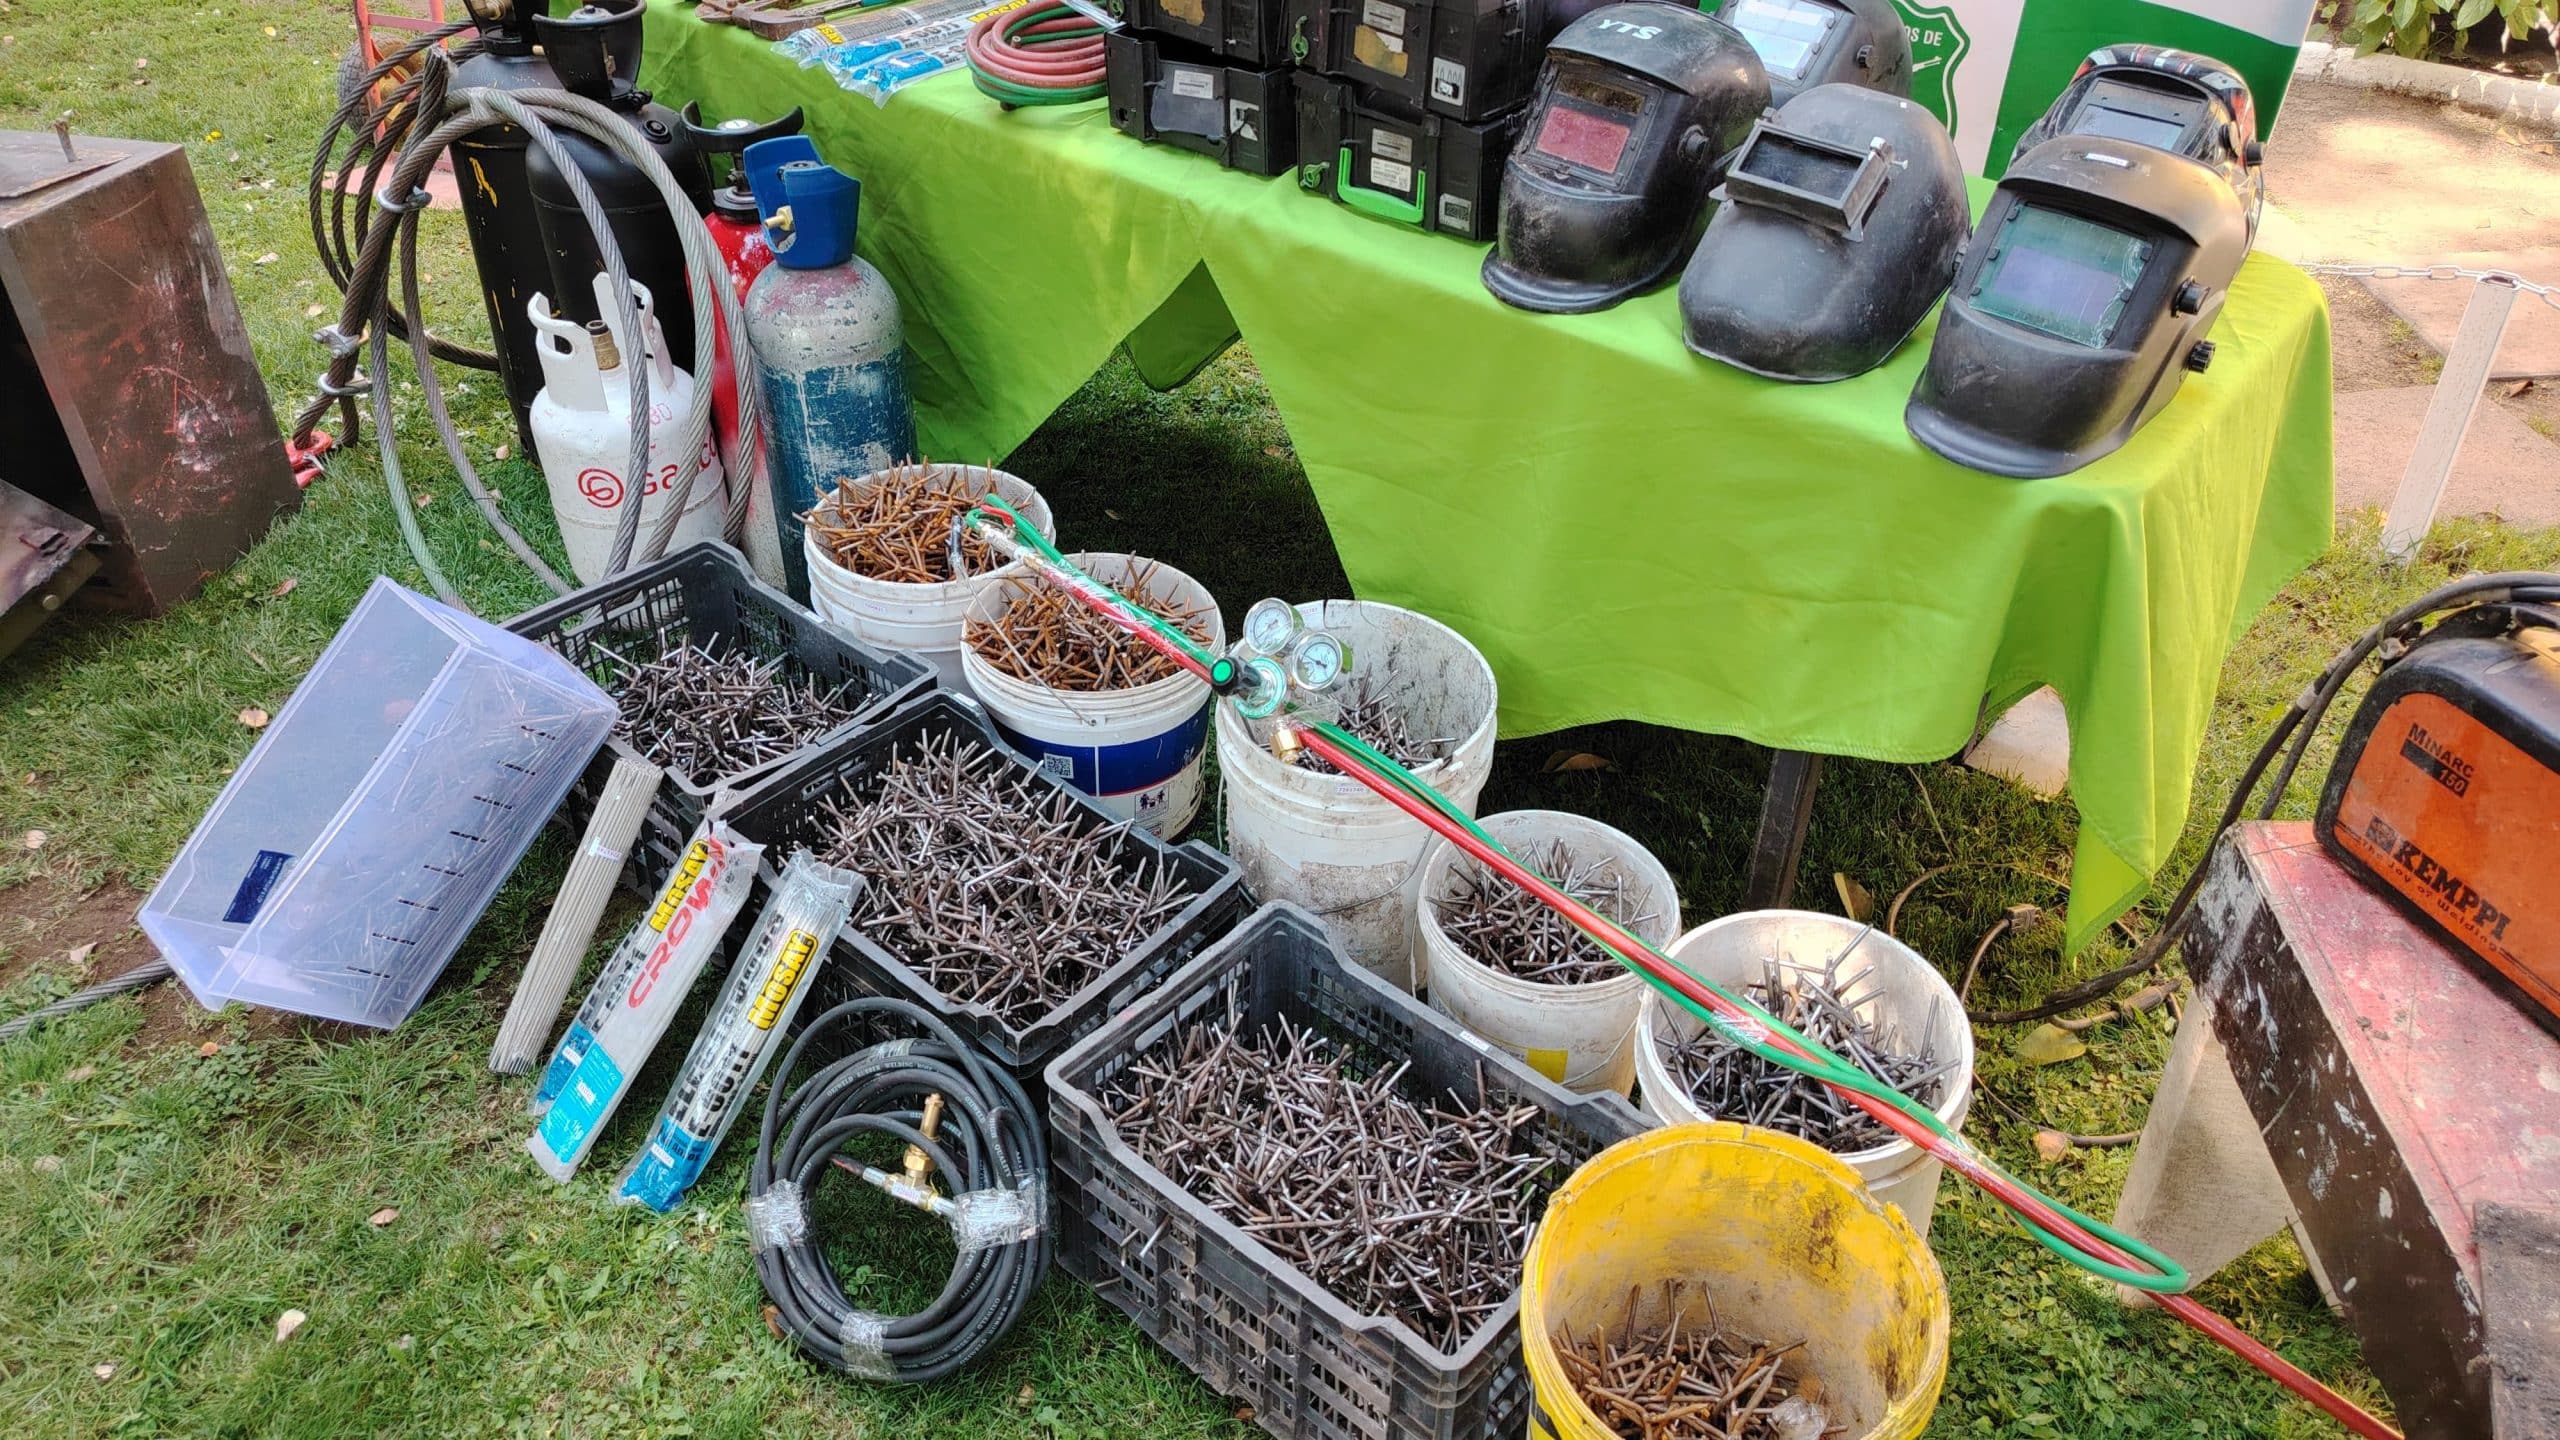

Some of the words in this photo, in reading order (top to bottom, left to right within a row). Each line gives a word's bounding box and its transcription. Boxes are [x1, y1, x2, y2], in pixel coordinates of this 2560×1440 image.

[1597, 19, 1663, 40] YTS
[1923, 28, 1944, 47] DE
[2408, 722, 2475, 779] MINARC
[2438, 770, 2466, 794] 150
[649, 841, 709, 934] MOSAY
[2393, 837, 2512, 940] KEMPPI
[748, 930, 814, 1030] MOSAY
[993, 1142, 1012, 1177] QUALITY
